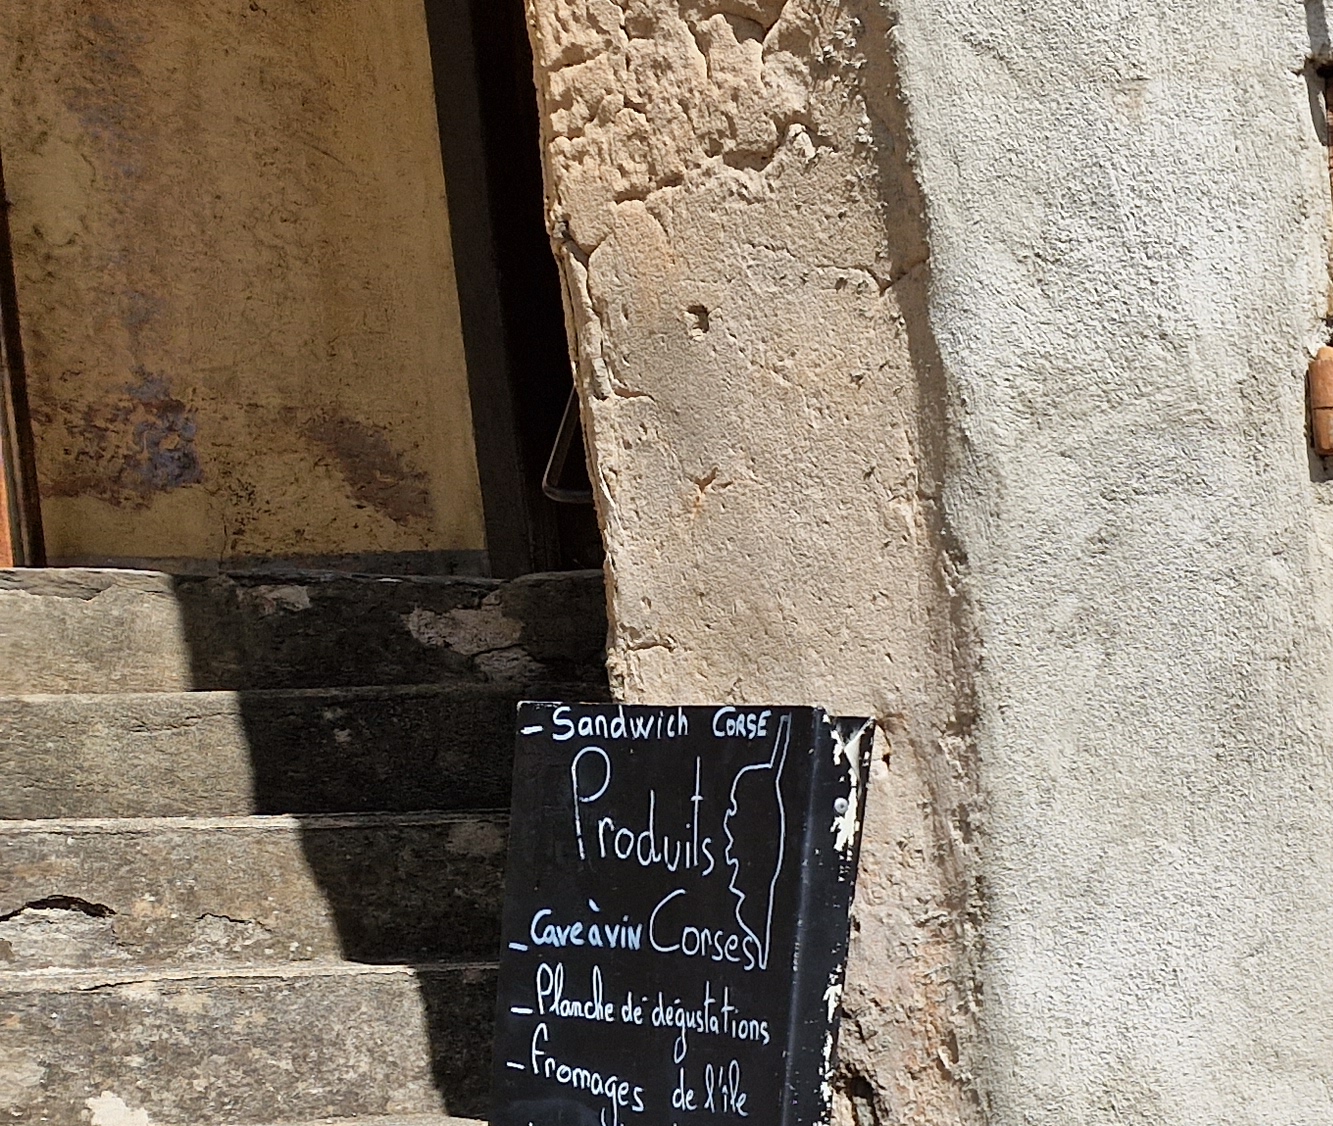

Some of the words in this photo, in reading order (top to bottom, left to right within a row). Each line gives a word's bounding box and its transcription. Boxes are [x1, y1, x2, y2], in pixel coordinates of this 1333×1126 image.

[712, 706, 772, 738] CORSE
[571, 746, 715, 876] Produits
[650, 888, 758, 971] Corses
[536, 962, 614, 1021] Planche
[651, 980, 770, 1064] dégustations
[672, 1067, 698, 1112] de
